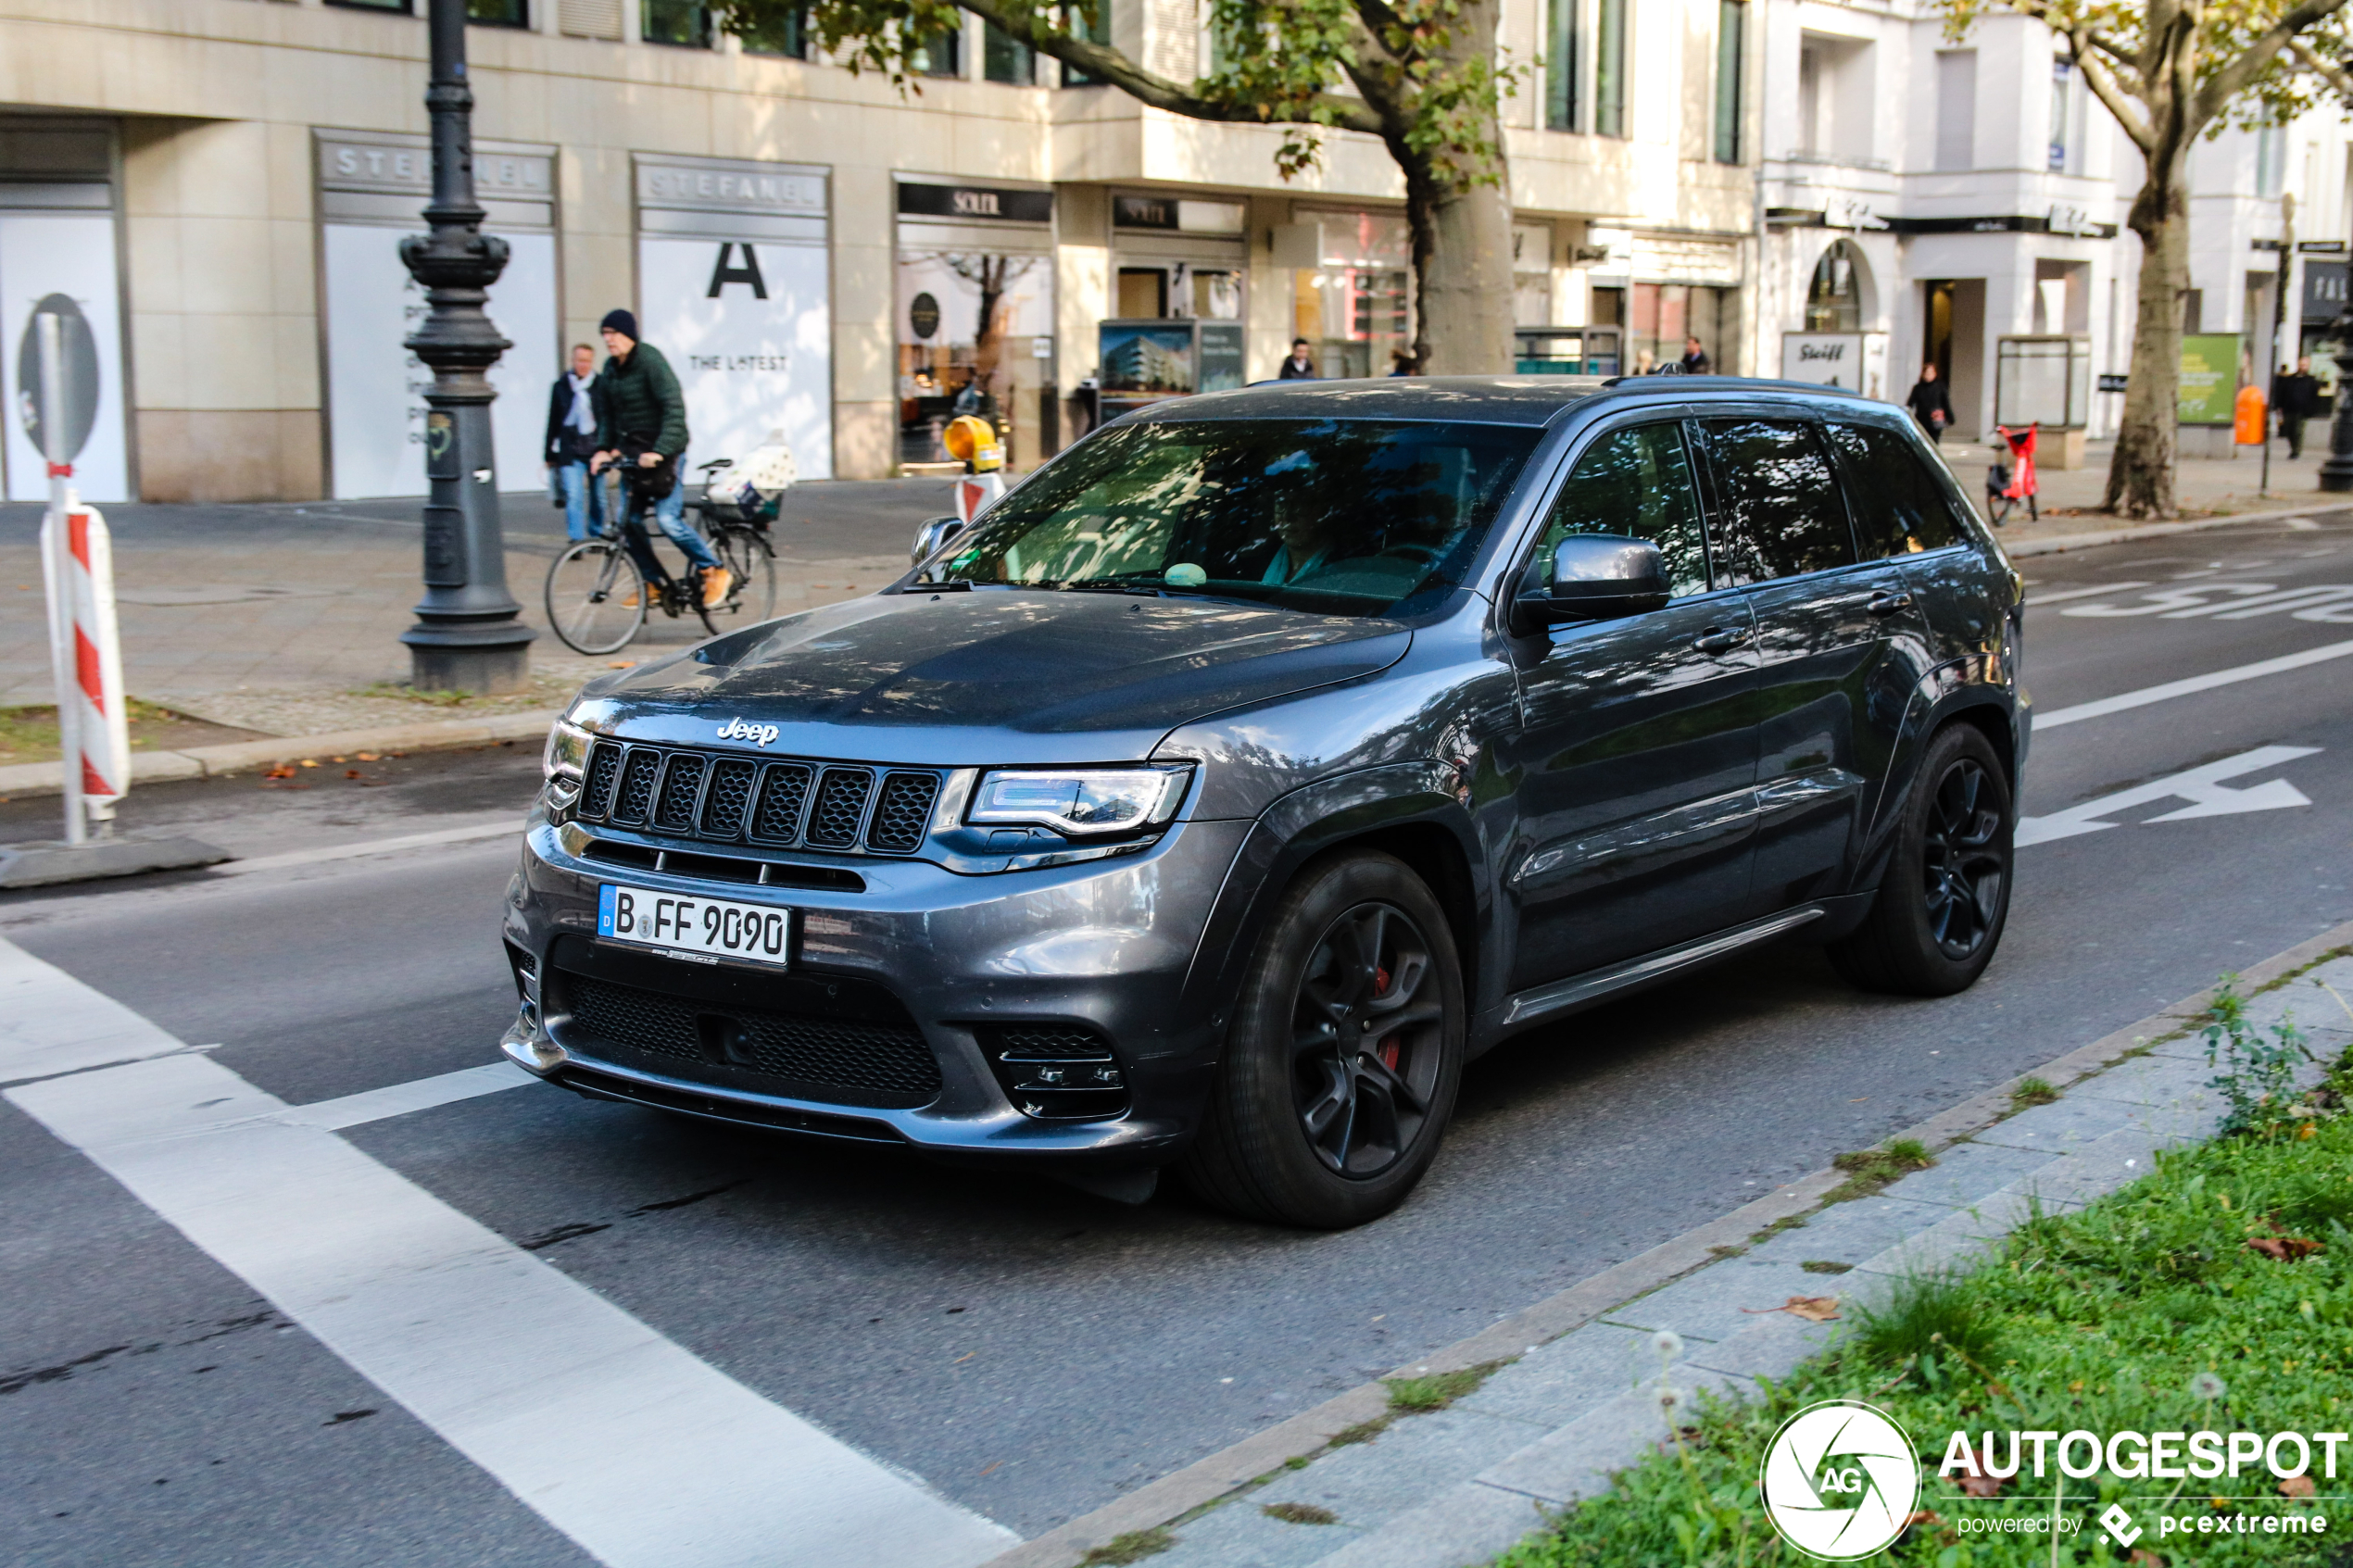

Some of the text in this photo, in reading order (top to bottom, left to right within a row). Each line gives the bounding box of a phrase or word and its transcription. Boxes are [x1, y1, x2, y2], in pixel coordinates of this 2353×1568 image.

[650, 172, 817, 205] STEFANEL
[689, 356, 786, 371] THE LATEST
[717, 716, 779, 748] Jeep
[603, 915, 611, 928] D
[616, 892, 784, 955] B FF 9090
